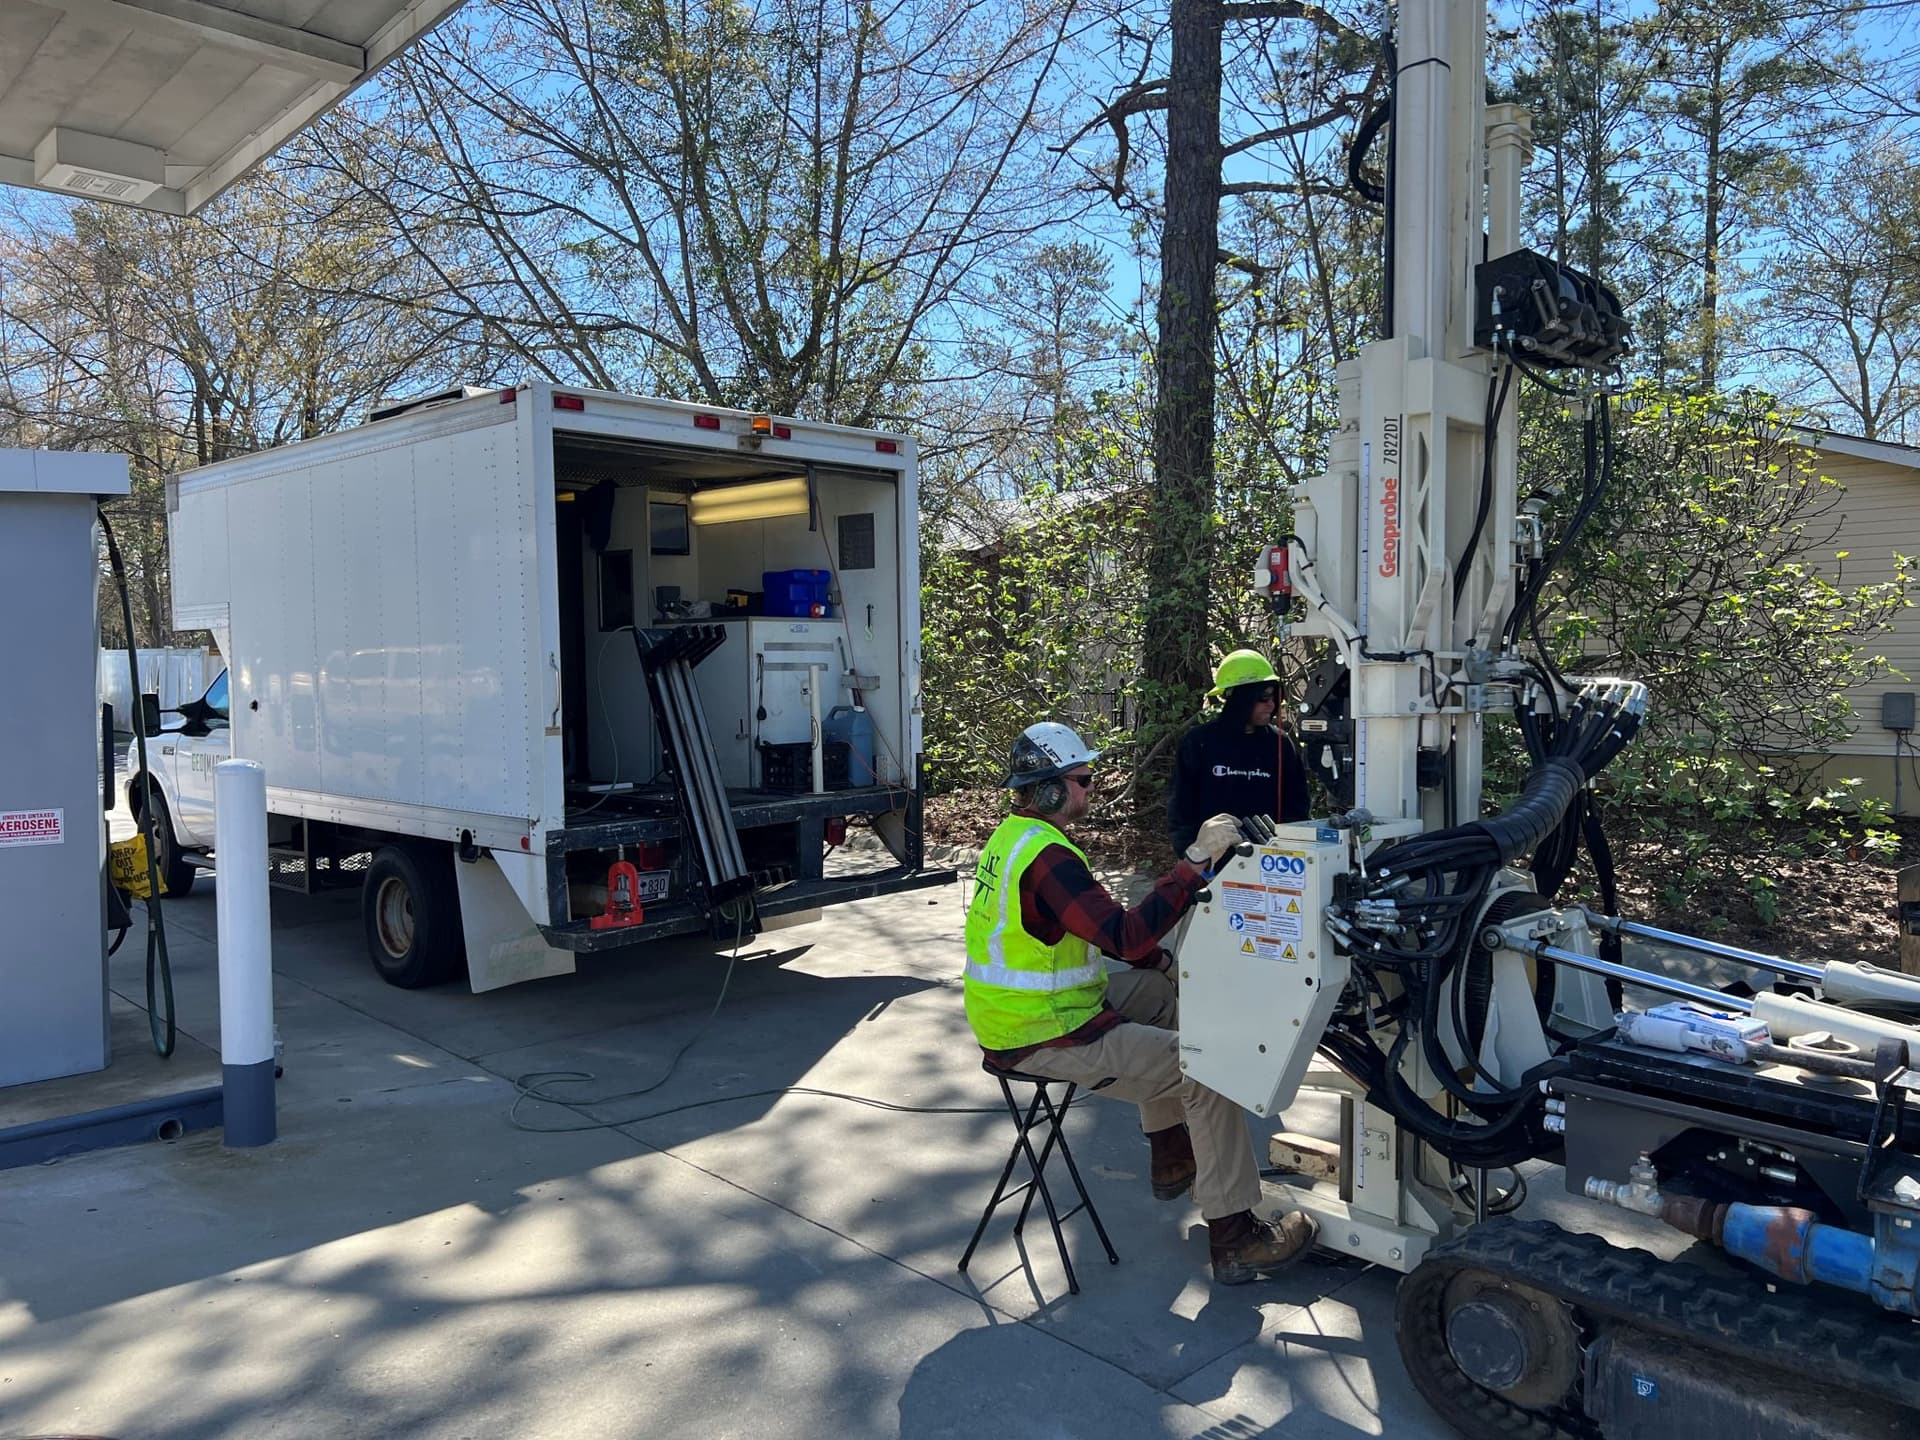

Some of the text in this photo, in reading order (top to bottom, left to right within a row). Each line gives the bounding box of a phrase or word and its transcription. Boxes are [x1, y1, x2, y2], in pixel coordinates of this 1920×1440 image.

[1383, 416, 1398, 465] 7822DT
[0, 818, 59, 831] KEROSENE
[123, 866, 135, 878] OF
[648, 879, 665, 892] 830
